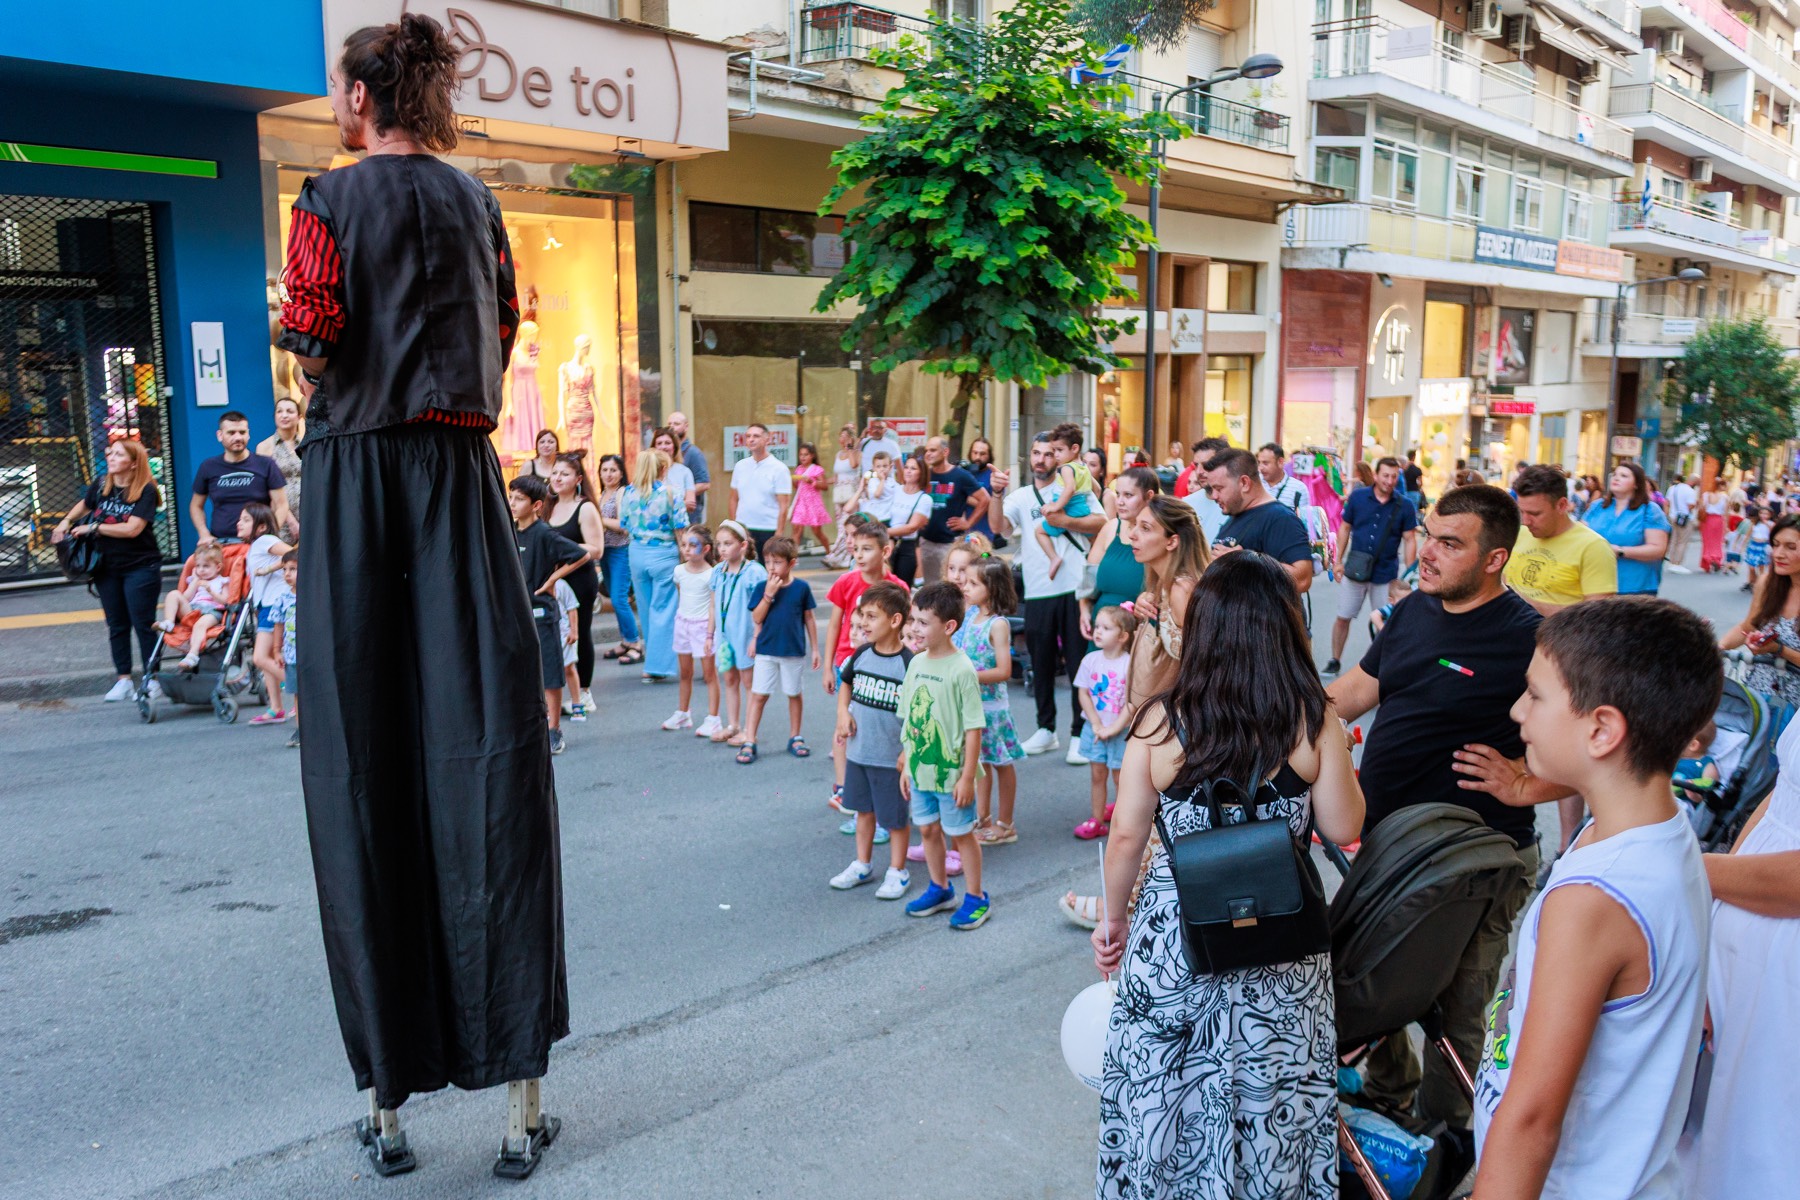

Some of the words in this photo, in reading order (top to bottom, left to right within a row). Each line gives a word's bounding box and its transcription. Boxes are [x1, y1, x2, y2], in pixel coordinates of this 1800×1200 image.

[458, 43, 552, 108] De
[571, 66, 635, 122] toi
[1476, 231, 1514, 261] ΞΕΝΕΣ
[217, 476, 255, 488] OXBOW
[1353, 1131, 1409, 1161] ΠΟΛΥΚΑΤΑΣ
